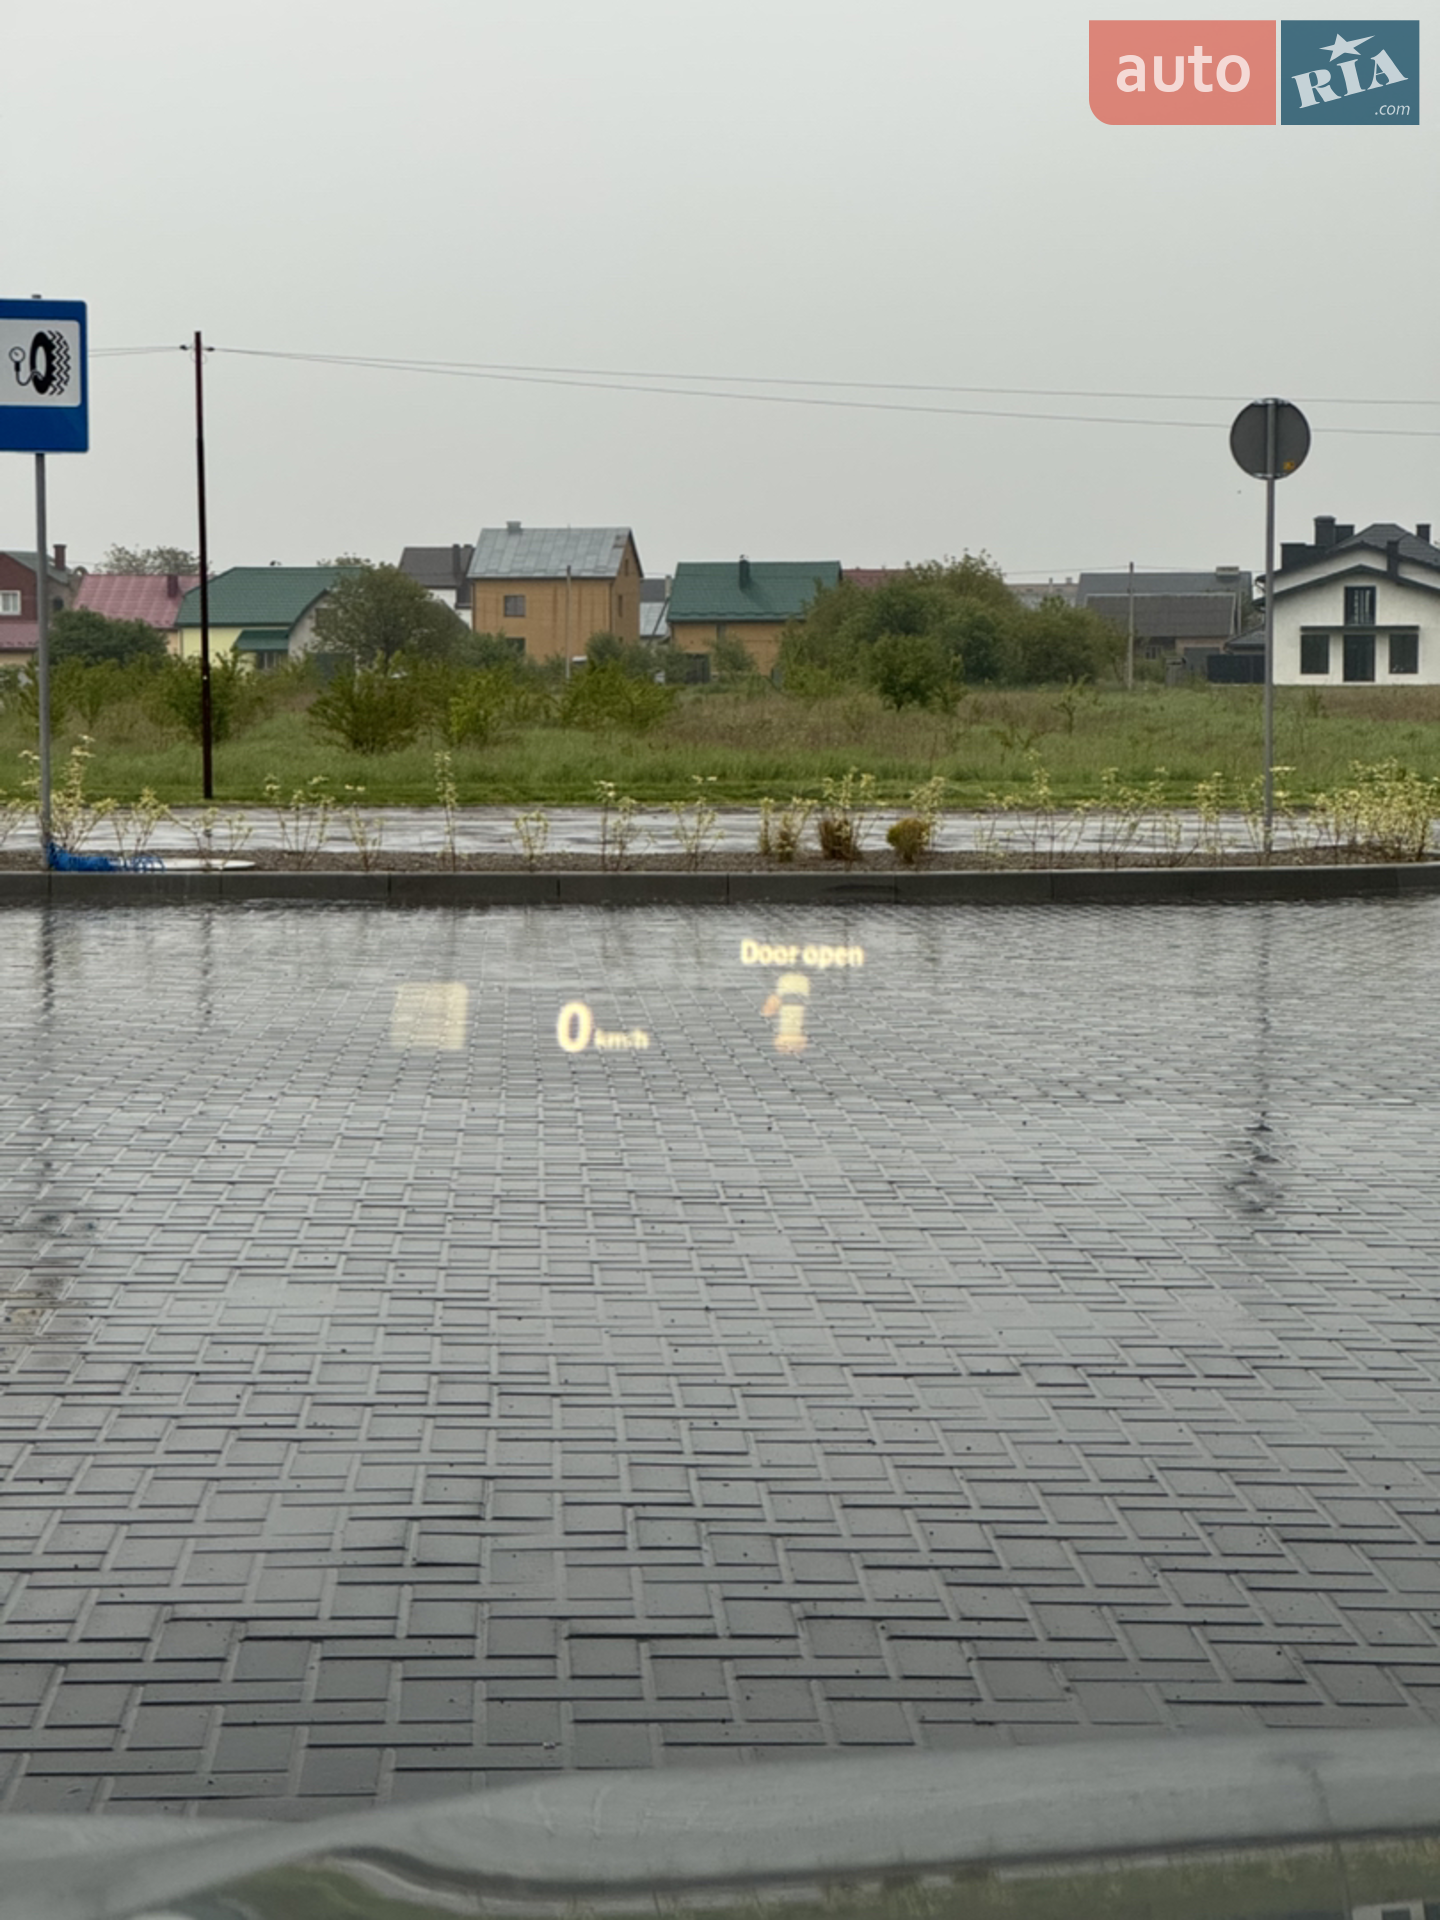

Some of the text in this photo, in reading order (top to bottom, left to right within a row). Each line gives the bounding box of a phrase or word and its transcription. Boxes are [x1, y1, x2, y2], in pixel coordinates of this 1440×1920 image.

[741, 939, 865, 969] Door open
[557, 1001, 593, 1053] 0
